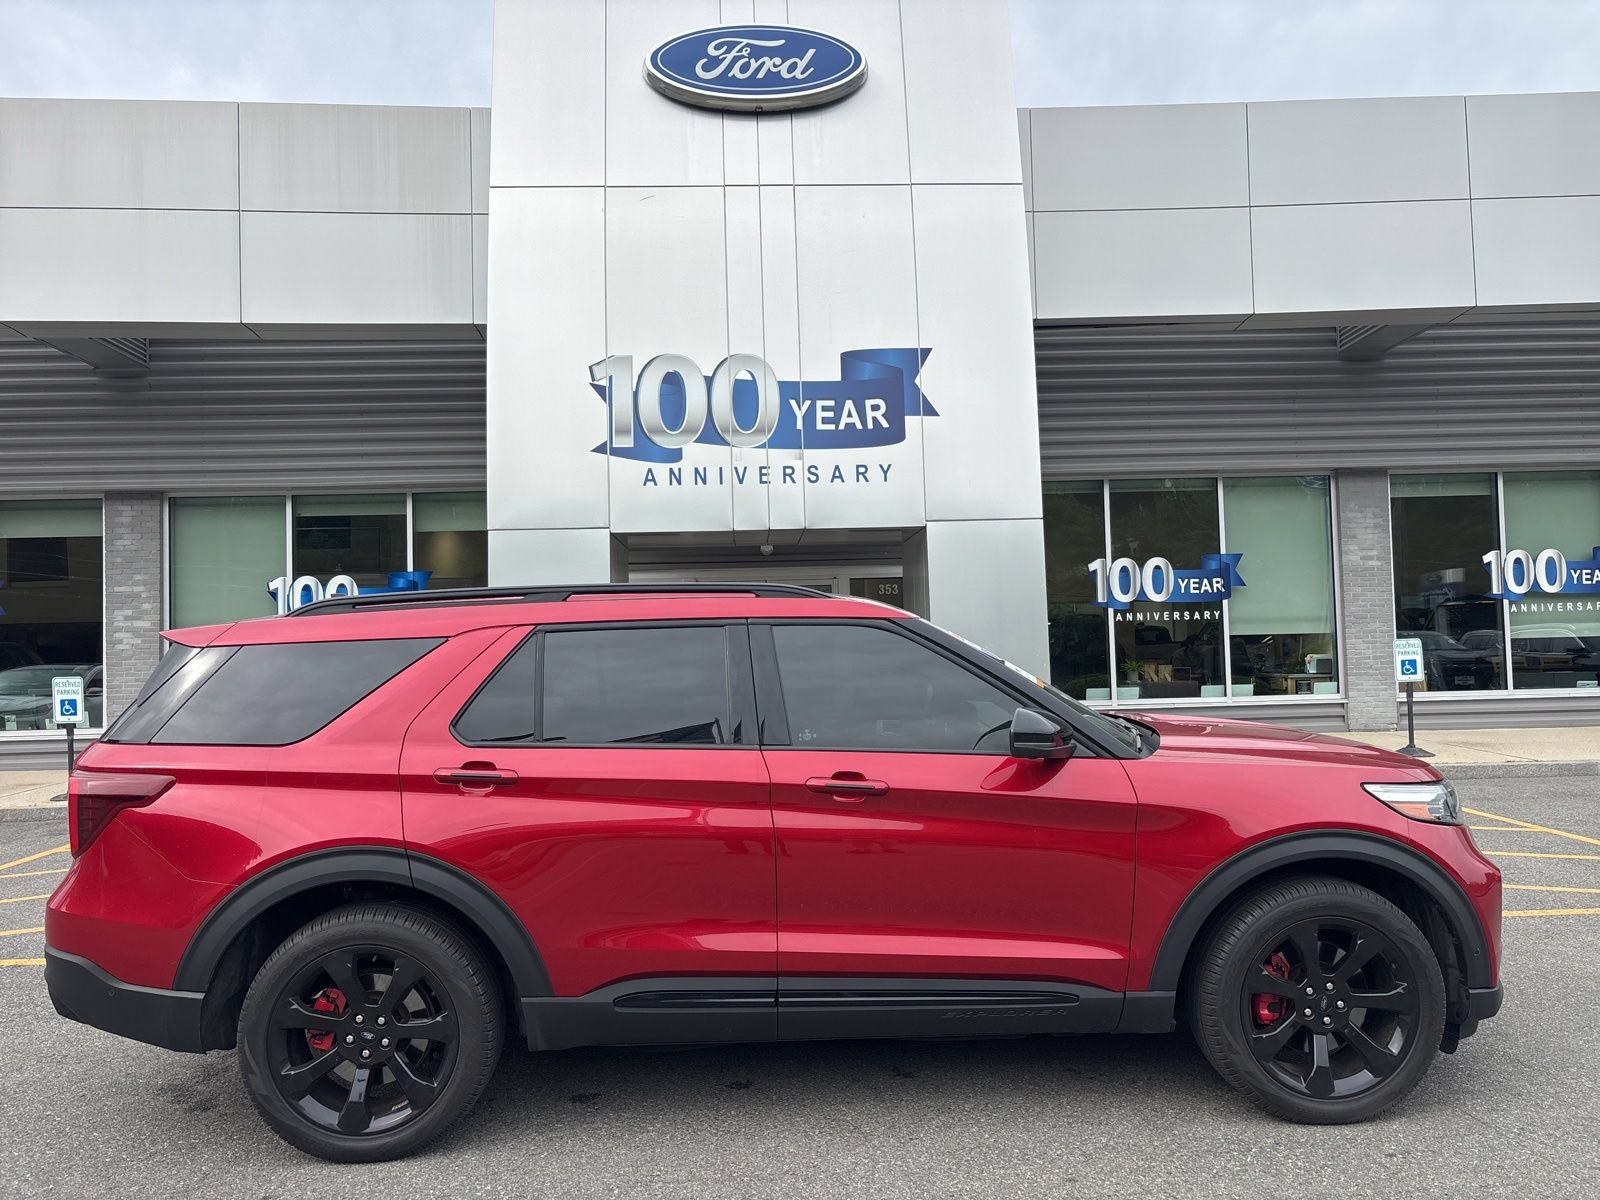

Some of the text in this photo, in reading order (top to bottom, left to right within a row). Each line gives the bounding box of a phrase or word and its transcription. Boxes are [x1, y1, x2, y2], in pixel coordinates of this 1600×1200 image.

[695, 37, 817, 80] Ford
[589, 353, 890, 449] 100 YEAR
[642, 463, 893, 487] ANNIVERSARY
[878, 583, 899, 595] 353
[1087, 556, 1226, 603] 100 YEAR
[1482, 548, 1567, 594] 100
[1115, 610, 1222, 622] ANNIVERSARY
